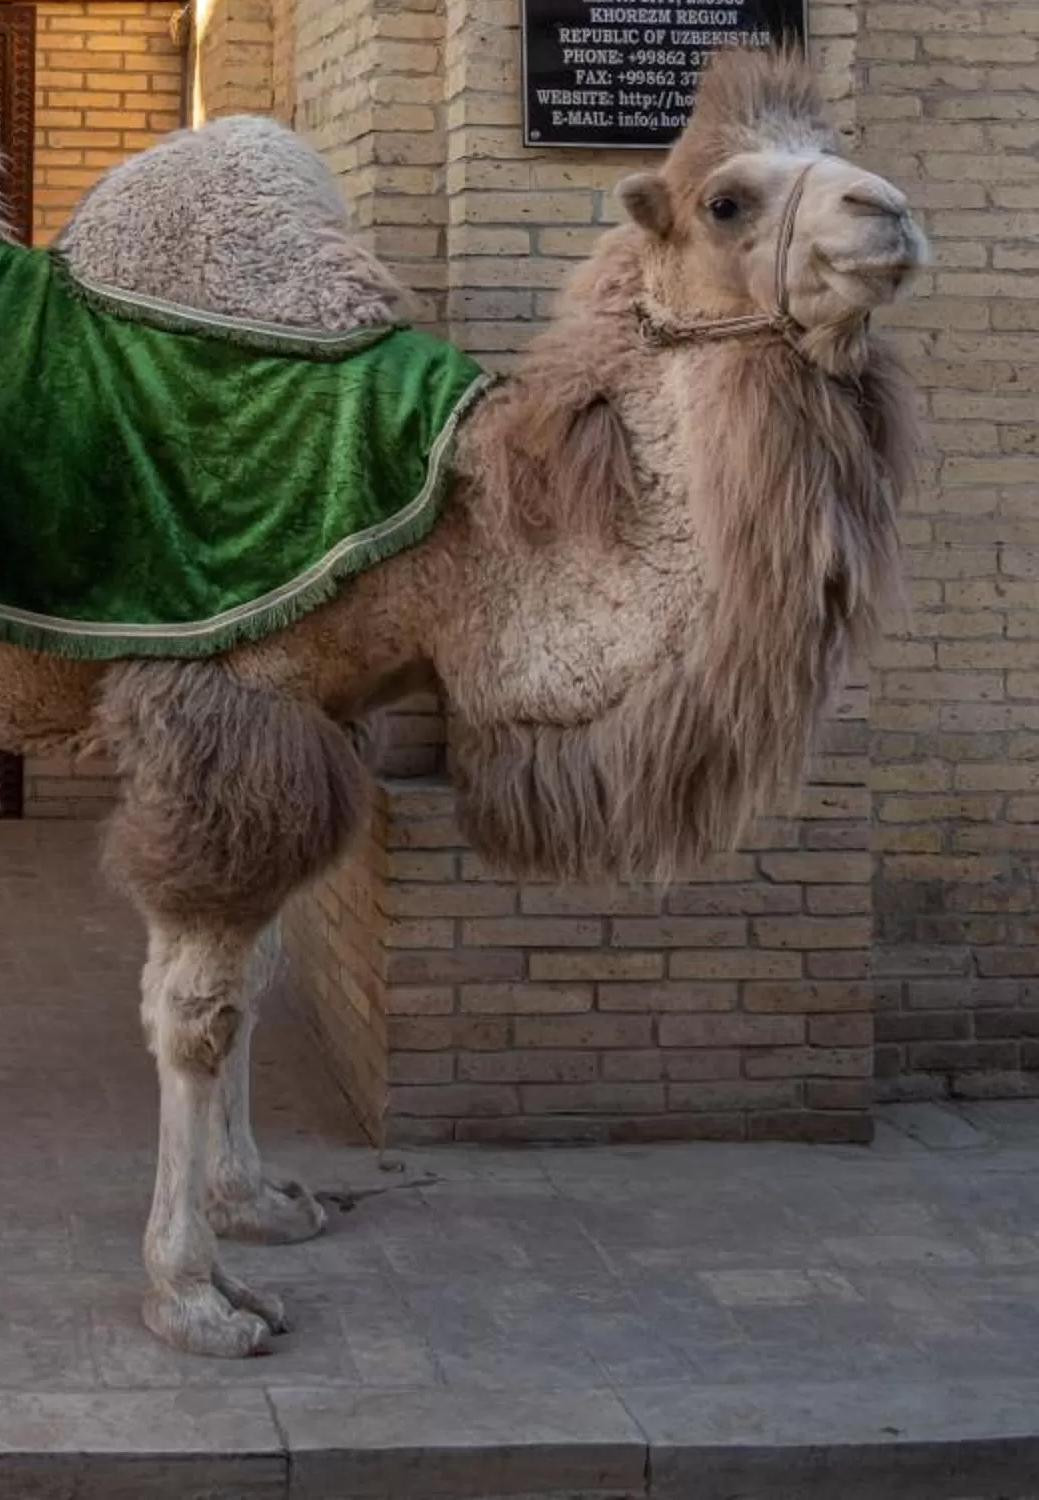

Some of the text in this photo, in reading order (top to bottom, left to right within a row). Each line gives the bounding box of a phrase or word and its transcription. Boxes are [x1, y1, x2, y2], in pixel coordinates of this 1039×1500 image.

[590, 8, 738, 25] KHOREZM REGION
[559, 28, 770, 46] REPUBLIC OF UZBEKISTAN
[563, 49, 624, 64] PHONE:
[628, 50, 686, 65] +99862
[575, 69, 613, 85] FAX:
[616, 71, 676, 85] +99862
[536, 89, 615, 105] WEBSITE:
[551, 111, 614, 126] E-MAIL:
